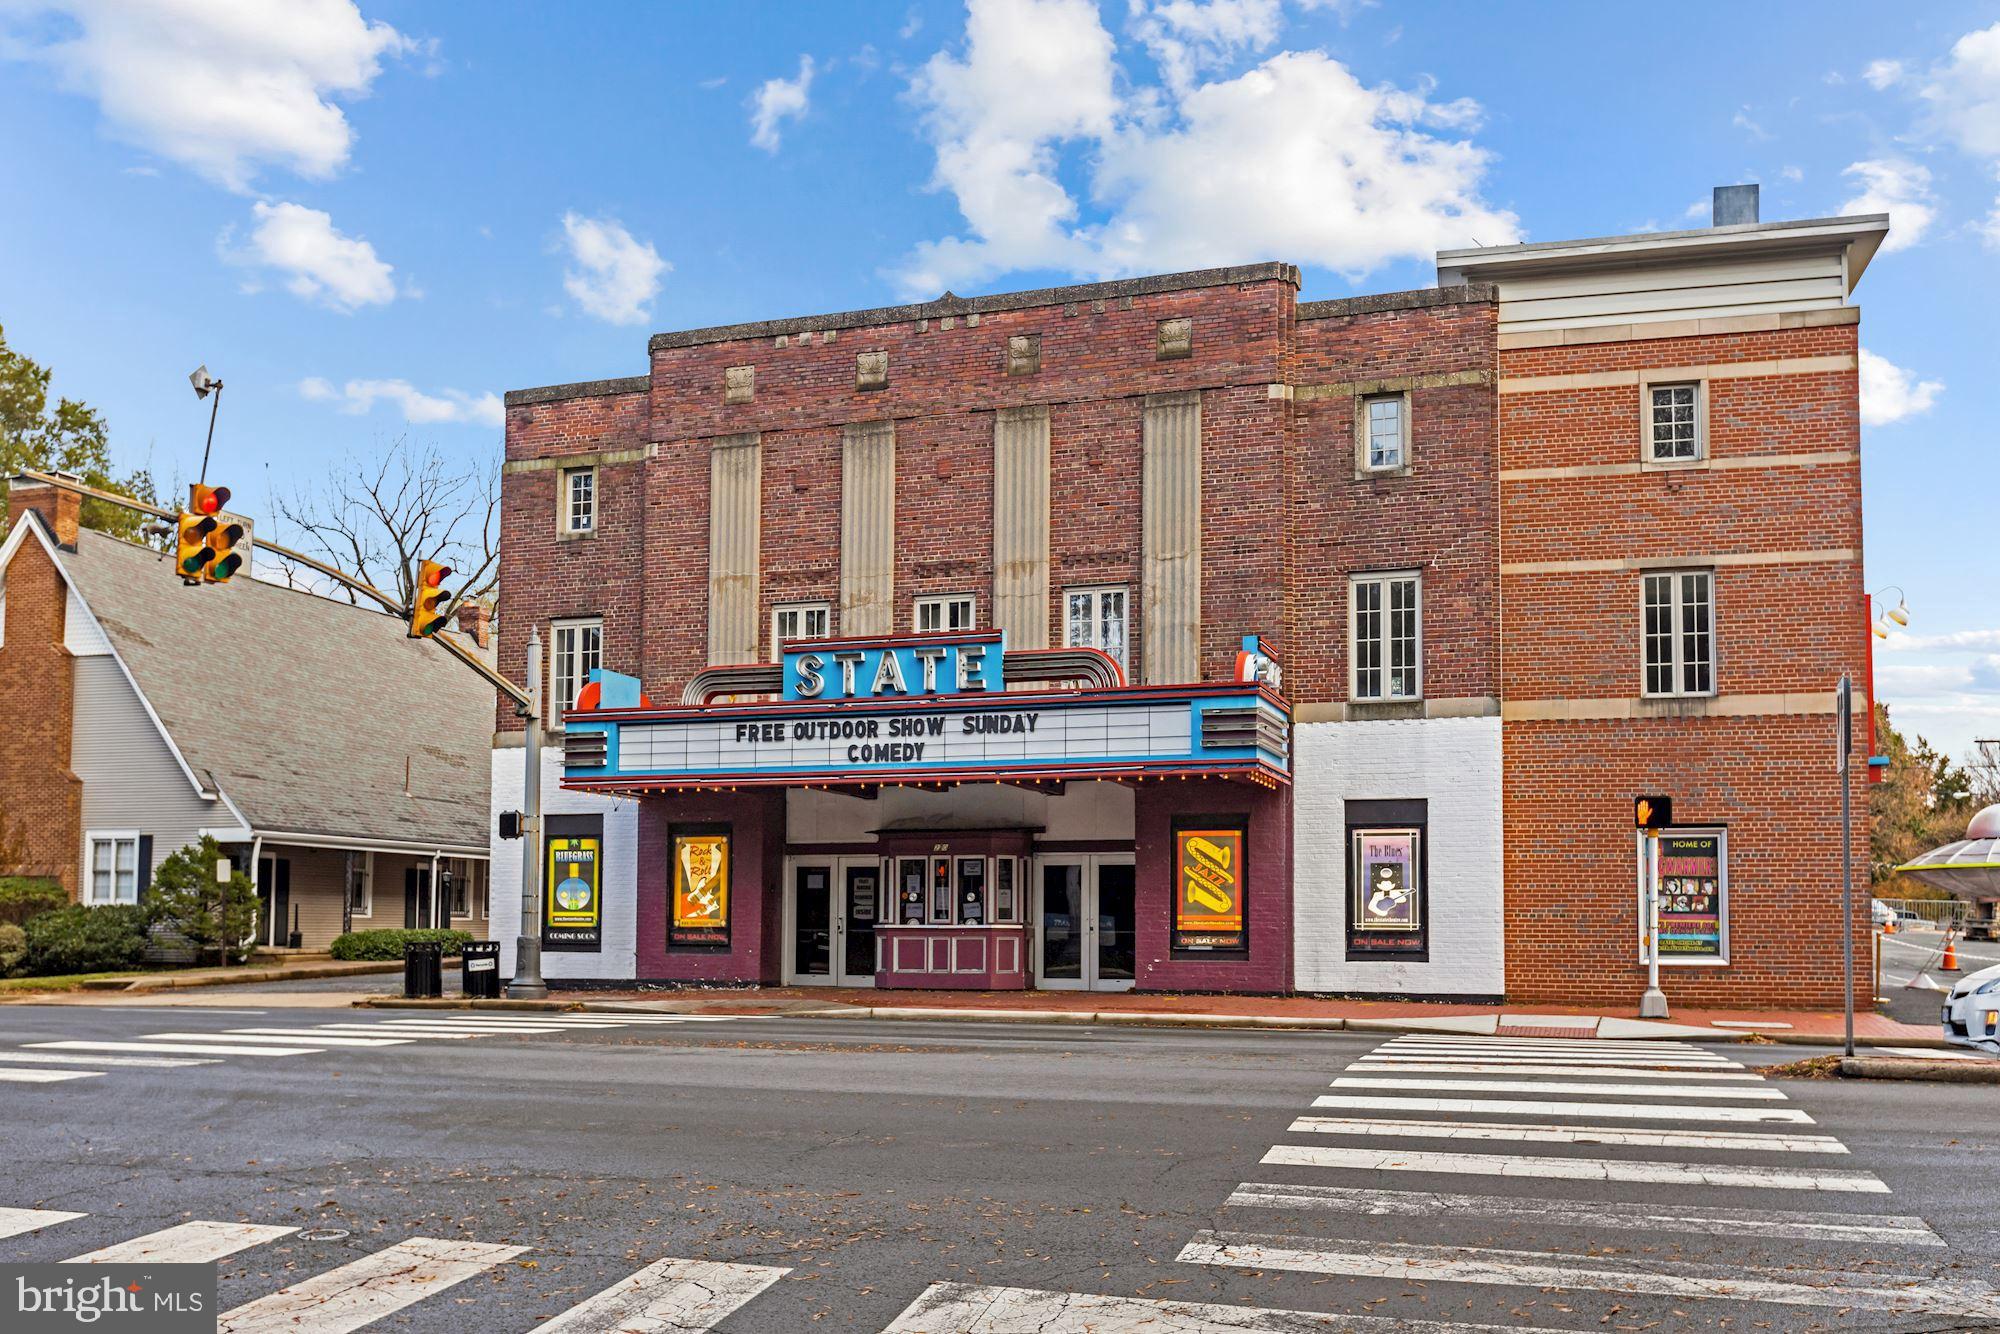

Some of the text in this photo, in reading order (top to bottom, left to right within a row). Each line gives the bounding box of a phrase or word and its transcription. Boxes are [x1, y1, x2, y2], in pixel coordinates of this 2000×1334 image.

[794, 645, 987, 697] STATE
[736, 713, 1039, 742] FREE OUTDOOR SHOW SUNDAY
[847, 742, 925, 763] COMEDY
[689, 844, 712, 857] Rock
[1370, 844, 1403, 857] The Blues
[1672, 840, 1712, 848] HOME OF
[555, 850, 594, 862] BLUEGRASS
[699, 857, 706, 866] &
[690, 865, 712, 878] Roll
[1193, 863, 1225, 887] JAZZ
[549, 932, 596, 940] COMING SOON
